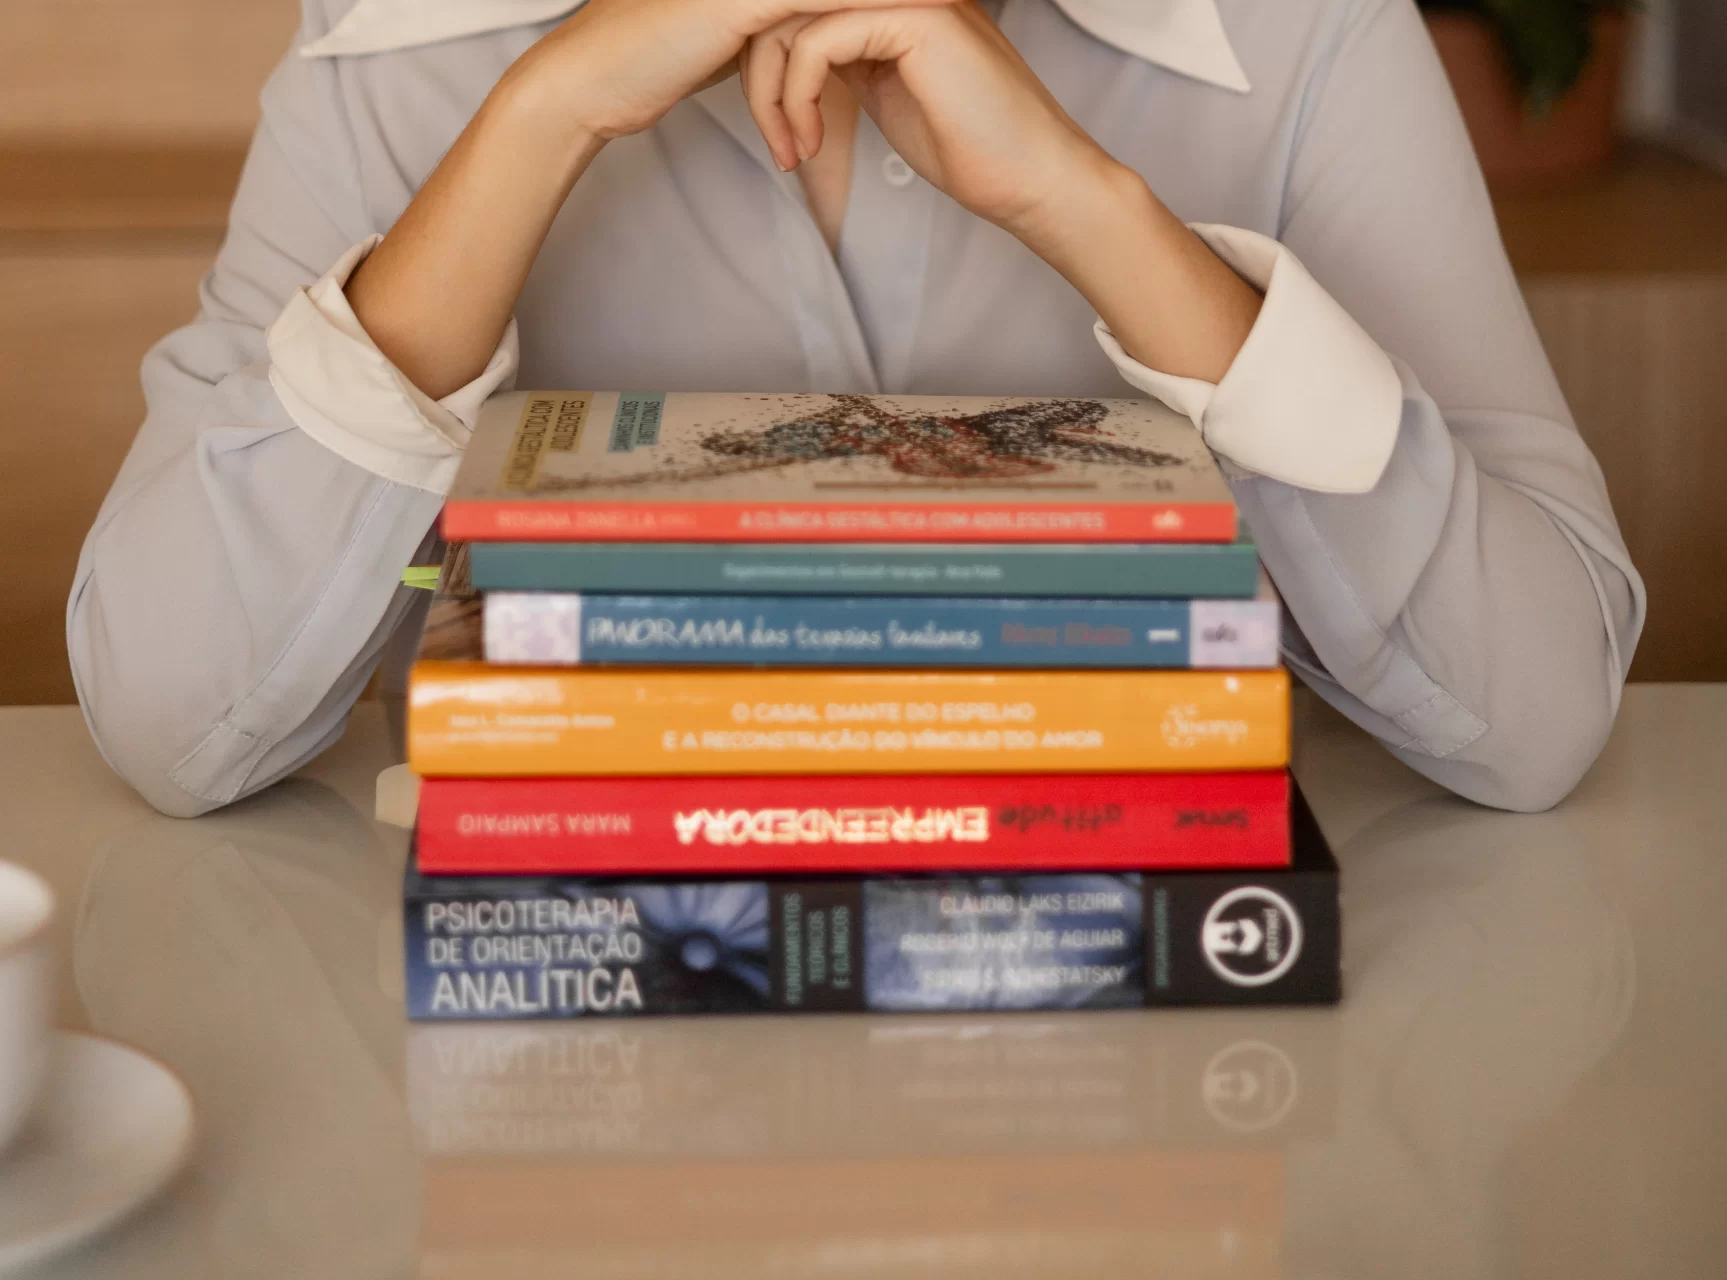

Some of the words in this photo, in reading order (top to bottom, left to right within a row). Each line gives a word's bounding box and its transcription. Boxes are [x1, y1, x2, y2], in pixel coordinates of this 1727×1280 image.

[529, 399, 555, 415] COM
[550, 399, 586, 451] ADOLESCENTES
[586, 617, 745, 649] PANORAMA
[731, 702, 750, 724] O
[753, 702, 822, 724] CASAL
[825, 702, 899, 724] DIANTE
[905, 702, 937, 724] DO
[941, 702, 1035, 724] ESPELHO
[662, 730, 678, 752] E
[681, 730, 698, 751] A
[873, 730, 907, 752] DO
[1003, 730, 1037, 751] DO
[1040, 730, 1104, 751] AMOR
[456, 813, 561, 837] SAMPAIO
[565, 813, 632, 835] MARA
[673, 807, 989, 846] EMPREENDEDORA
[1019, 892, 1062, 913] LAKS
[1067, 891, 1125, 911] EIZIRIK
[426, 898, 641, 934] PSICOTERAPIA
[429, 936, 466, 965] DE
[471, 927, 643, 966] ORIENTAÇÃO
[1033, 930, 1056, 949] DE
[1060, 927, 1125, 948] AGUIAR
